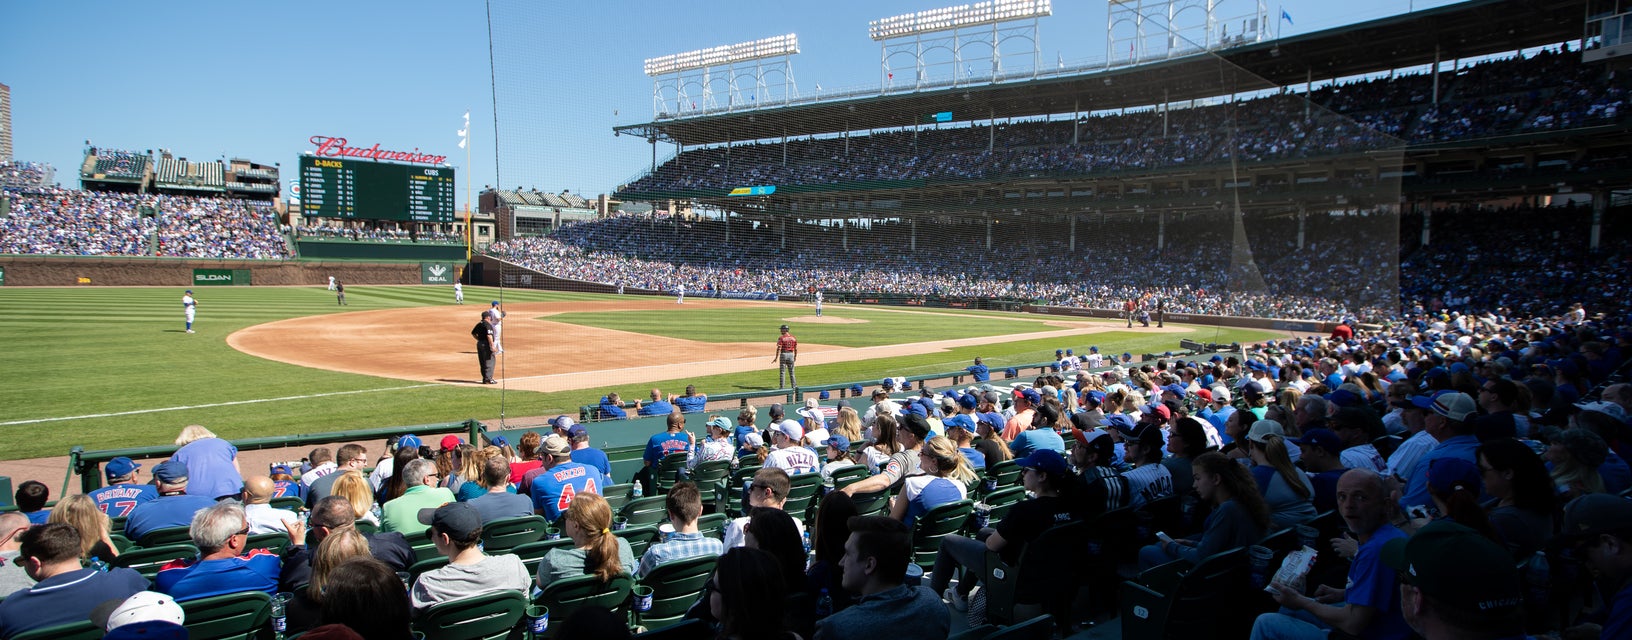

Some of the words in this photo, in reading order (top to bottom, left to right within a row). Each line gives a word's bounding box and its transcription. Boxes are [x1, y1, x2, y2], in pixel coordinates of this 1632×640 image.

[309, 135, 446, 165] Budweiser
[314, 159, 343, 168] D-BACKS
[424, 168, 439, 176] CUBS
[786, 452, 814, 467] RIZZO
[554, 466, 585, 482] RIZZO
[97, 487, 143, 503] BRYANT
